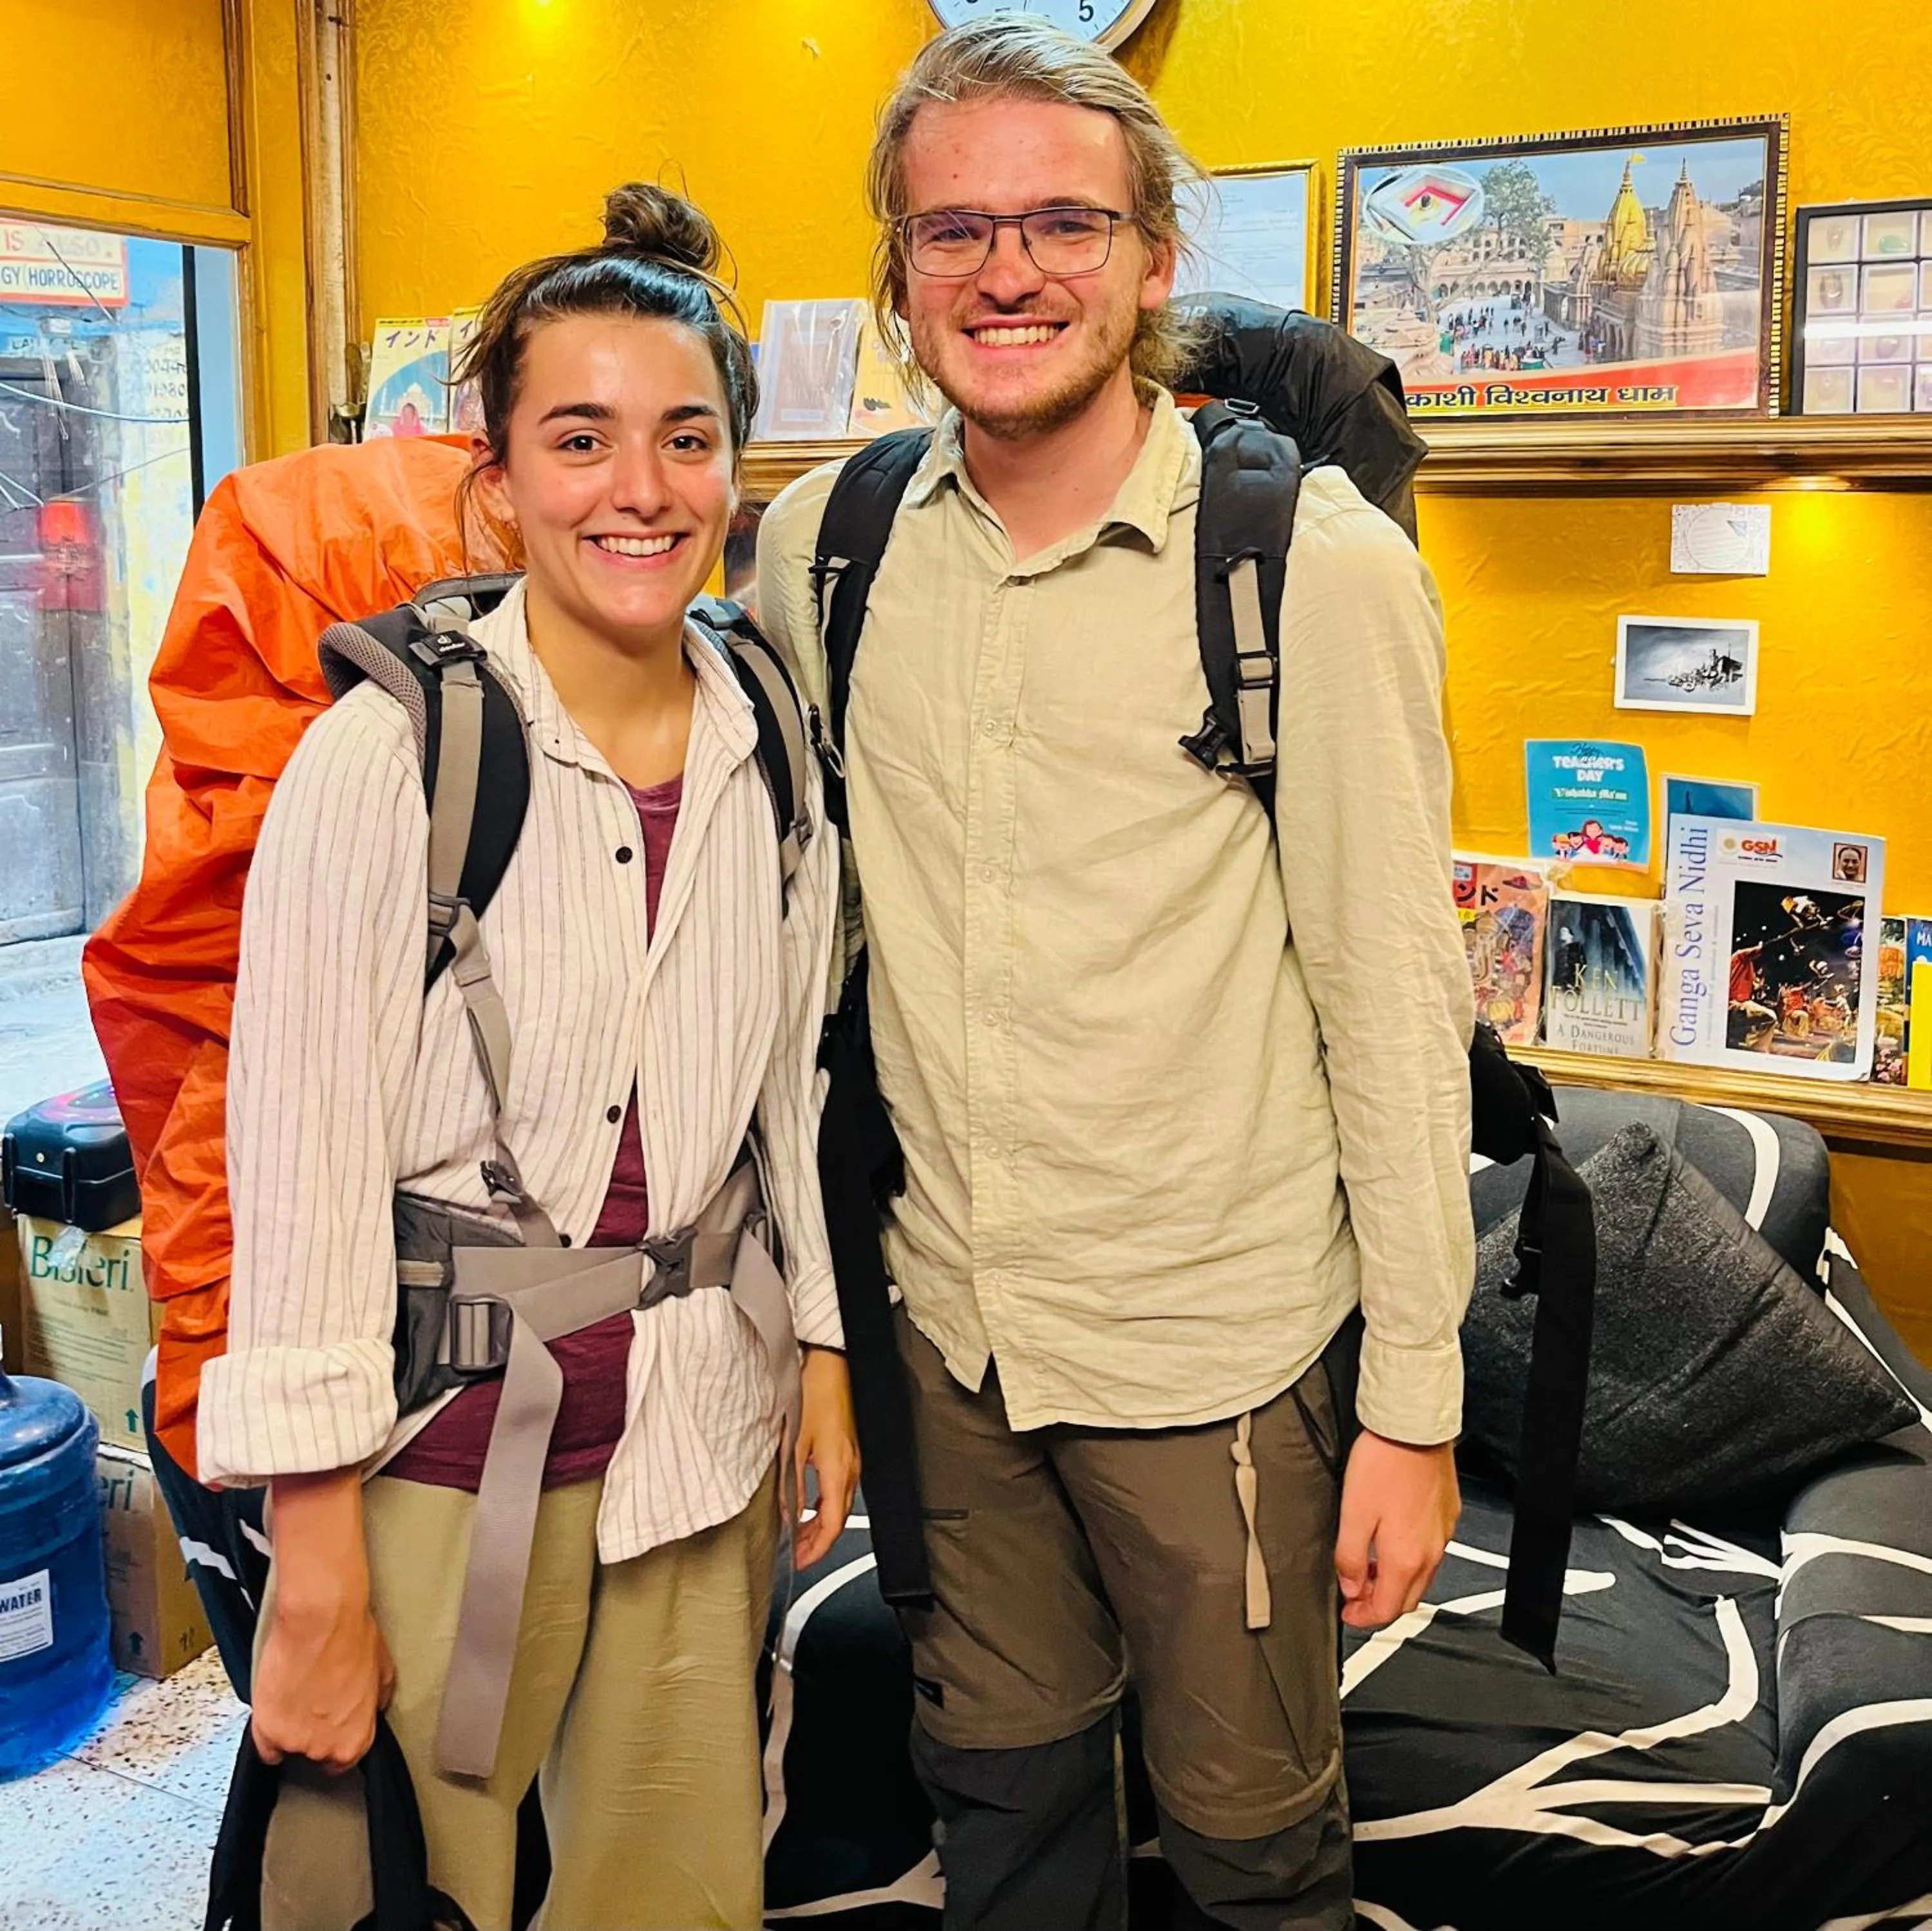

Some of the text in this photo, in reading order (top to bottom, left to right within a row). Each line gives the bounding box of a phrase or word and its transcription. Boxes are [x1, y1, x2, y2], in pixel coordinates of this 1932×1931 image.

[1079, 0, 1094, 22] 5
[4, 229, 24, 251] IS
[386, 329, 439, 348] インド
[1405, 385, 1676, 406] काशी विश्वनाथ धाम
[1577, 769, 1604, 782] DAY
[1669, 827, 1708, 1046] Ganga Seva Nidhi
[1575, 963, 1618, 989] KEN
[1557, 1024, 1565, 1036] A
[1571, 1025, 1634, 1045] DANGEROUS
[0, 1588, 41, 1613] WATER
